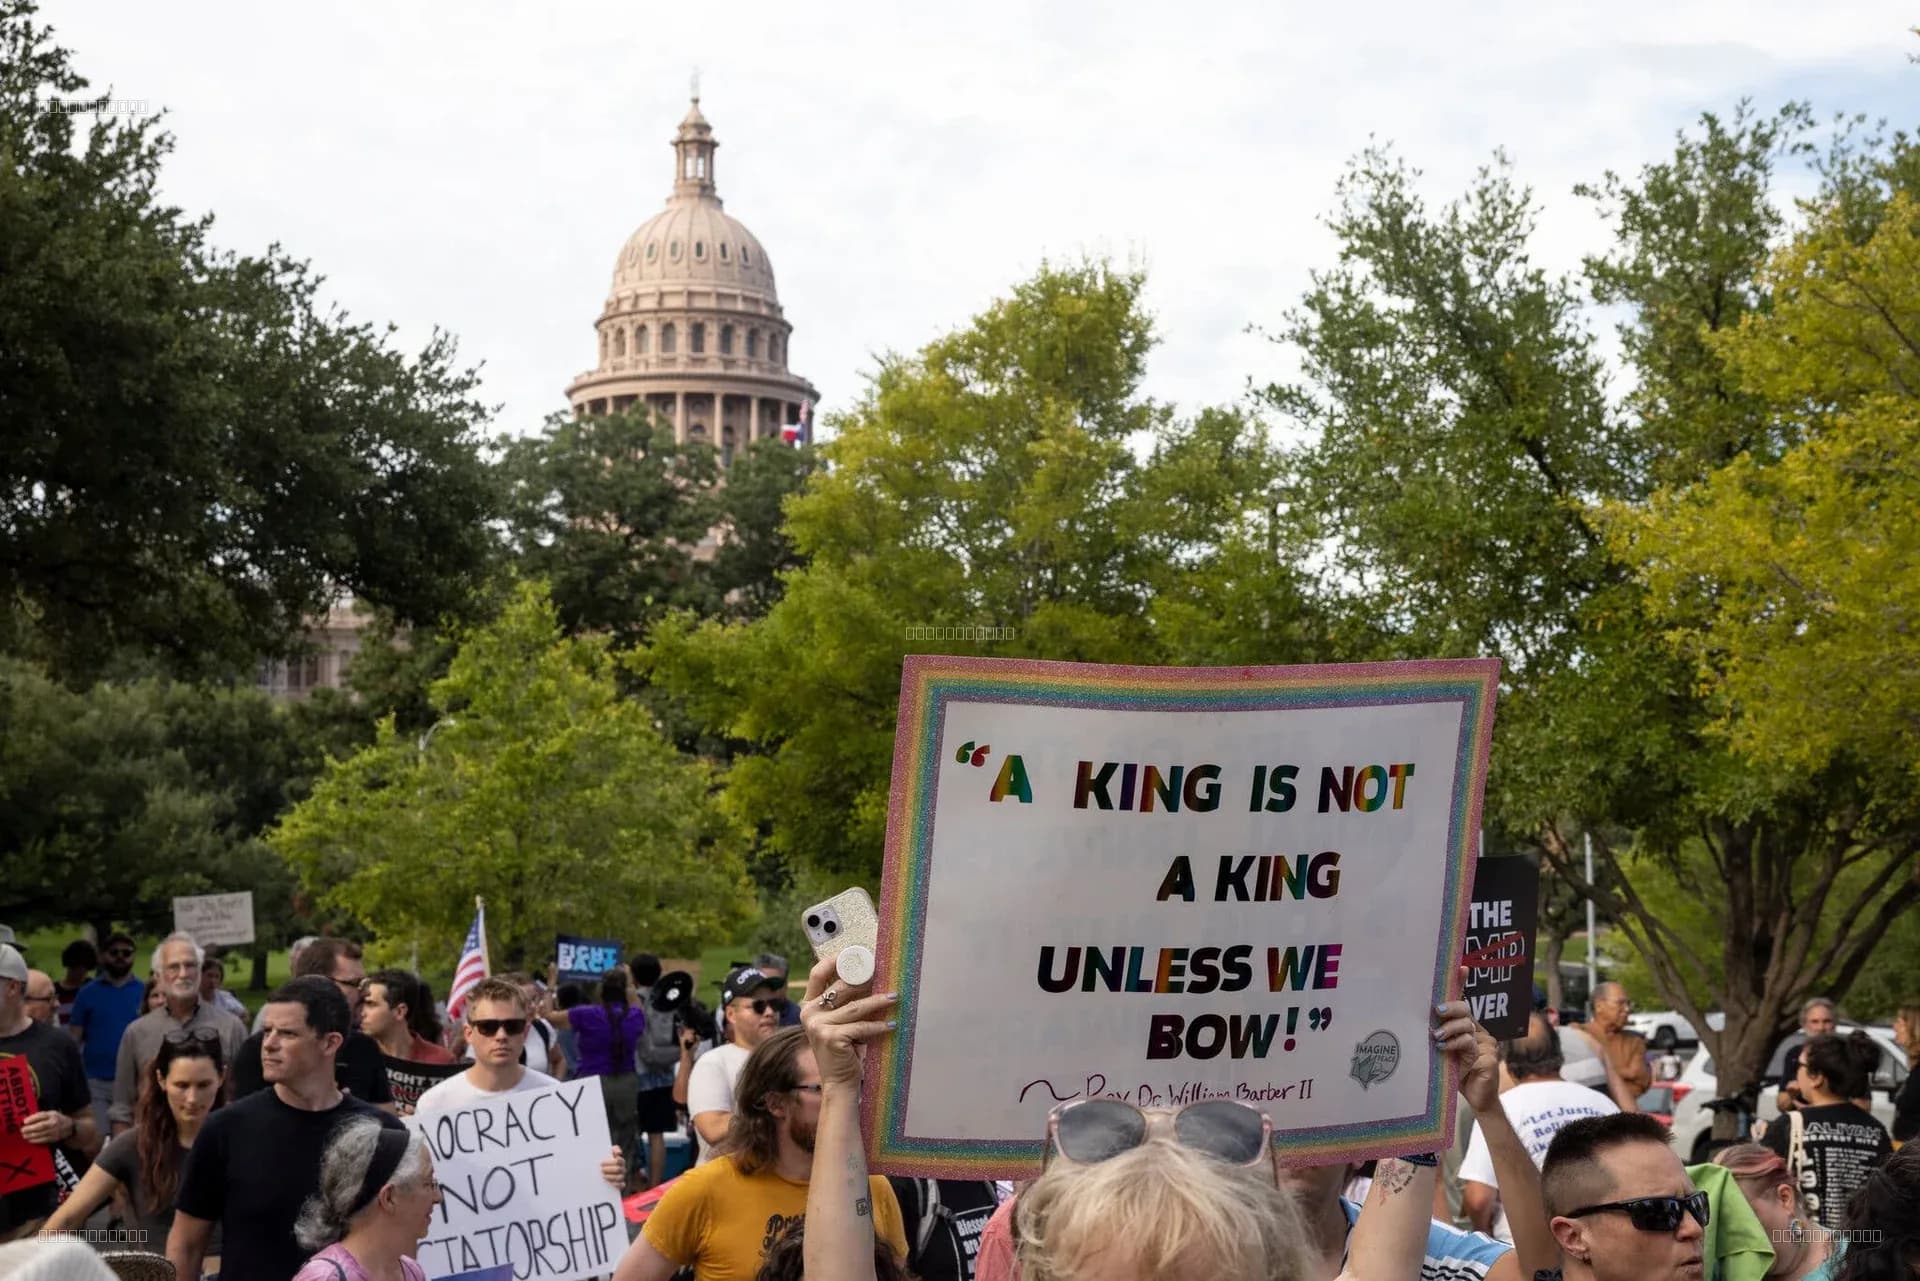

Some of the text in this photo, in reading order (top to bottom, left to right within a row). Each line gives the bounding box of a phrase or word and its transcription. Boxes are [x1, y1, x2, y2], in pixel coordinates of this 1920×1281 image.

[956, 741, 1416, 814] “A KING IS NOT
[1156, 851, 1341, 902] A KING
[1470, 900, 1513, 929] THE
[1037, 943, 1343, 994] UNLESS WE
[1464, 992, 1509, 1022] VER
[1355, 1043, 1397, 1055] IMAGINE
[8, 1066, 30, 1117] ABBOT
[385, 1067, 425, 1086] IGHT
[1236, 1081, 1296, 1101] Barber
[1299, 1078, 1314, 1100] II
[419, 1085, 584, 1162] OCRACY
[438, 1153, 554, 1224] NOT
[417, 1202, 617, 1280] TATORSHIP
